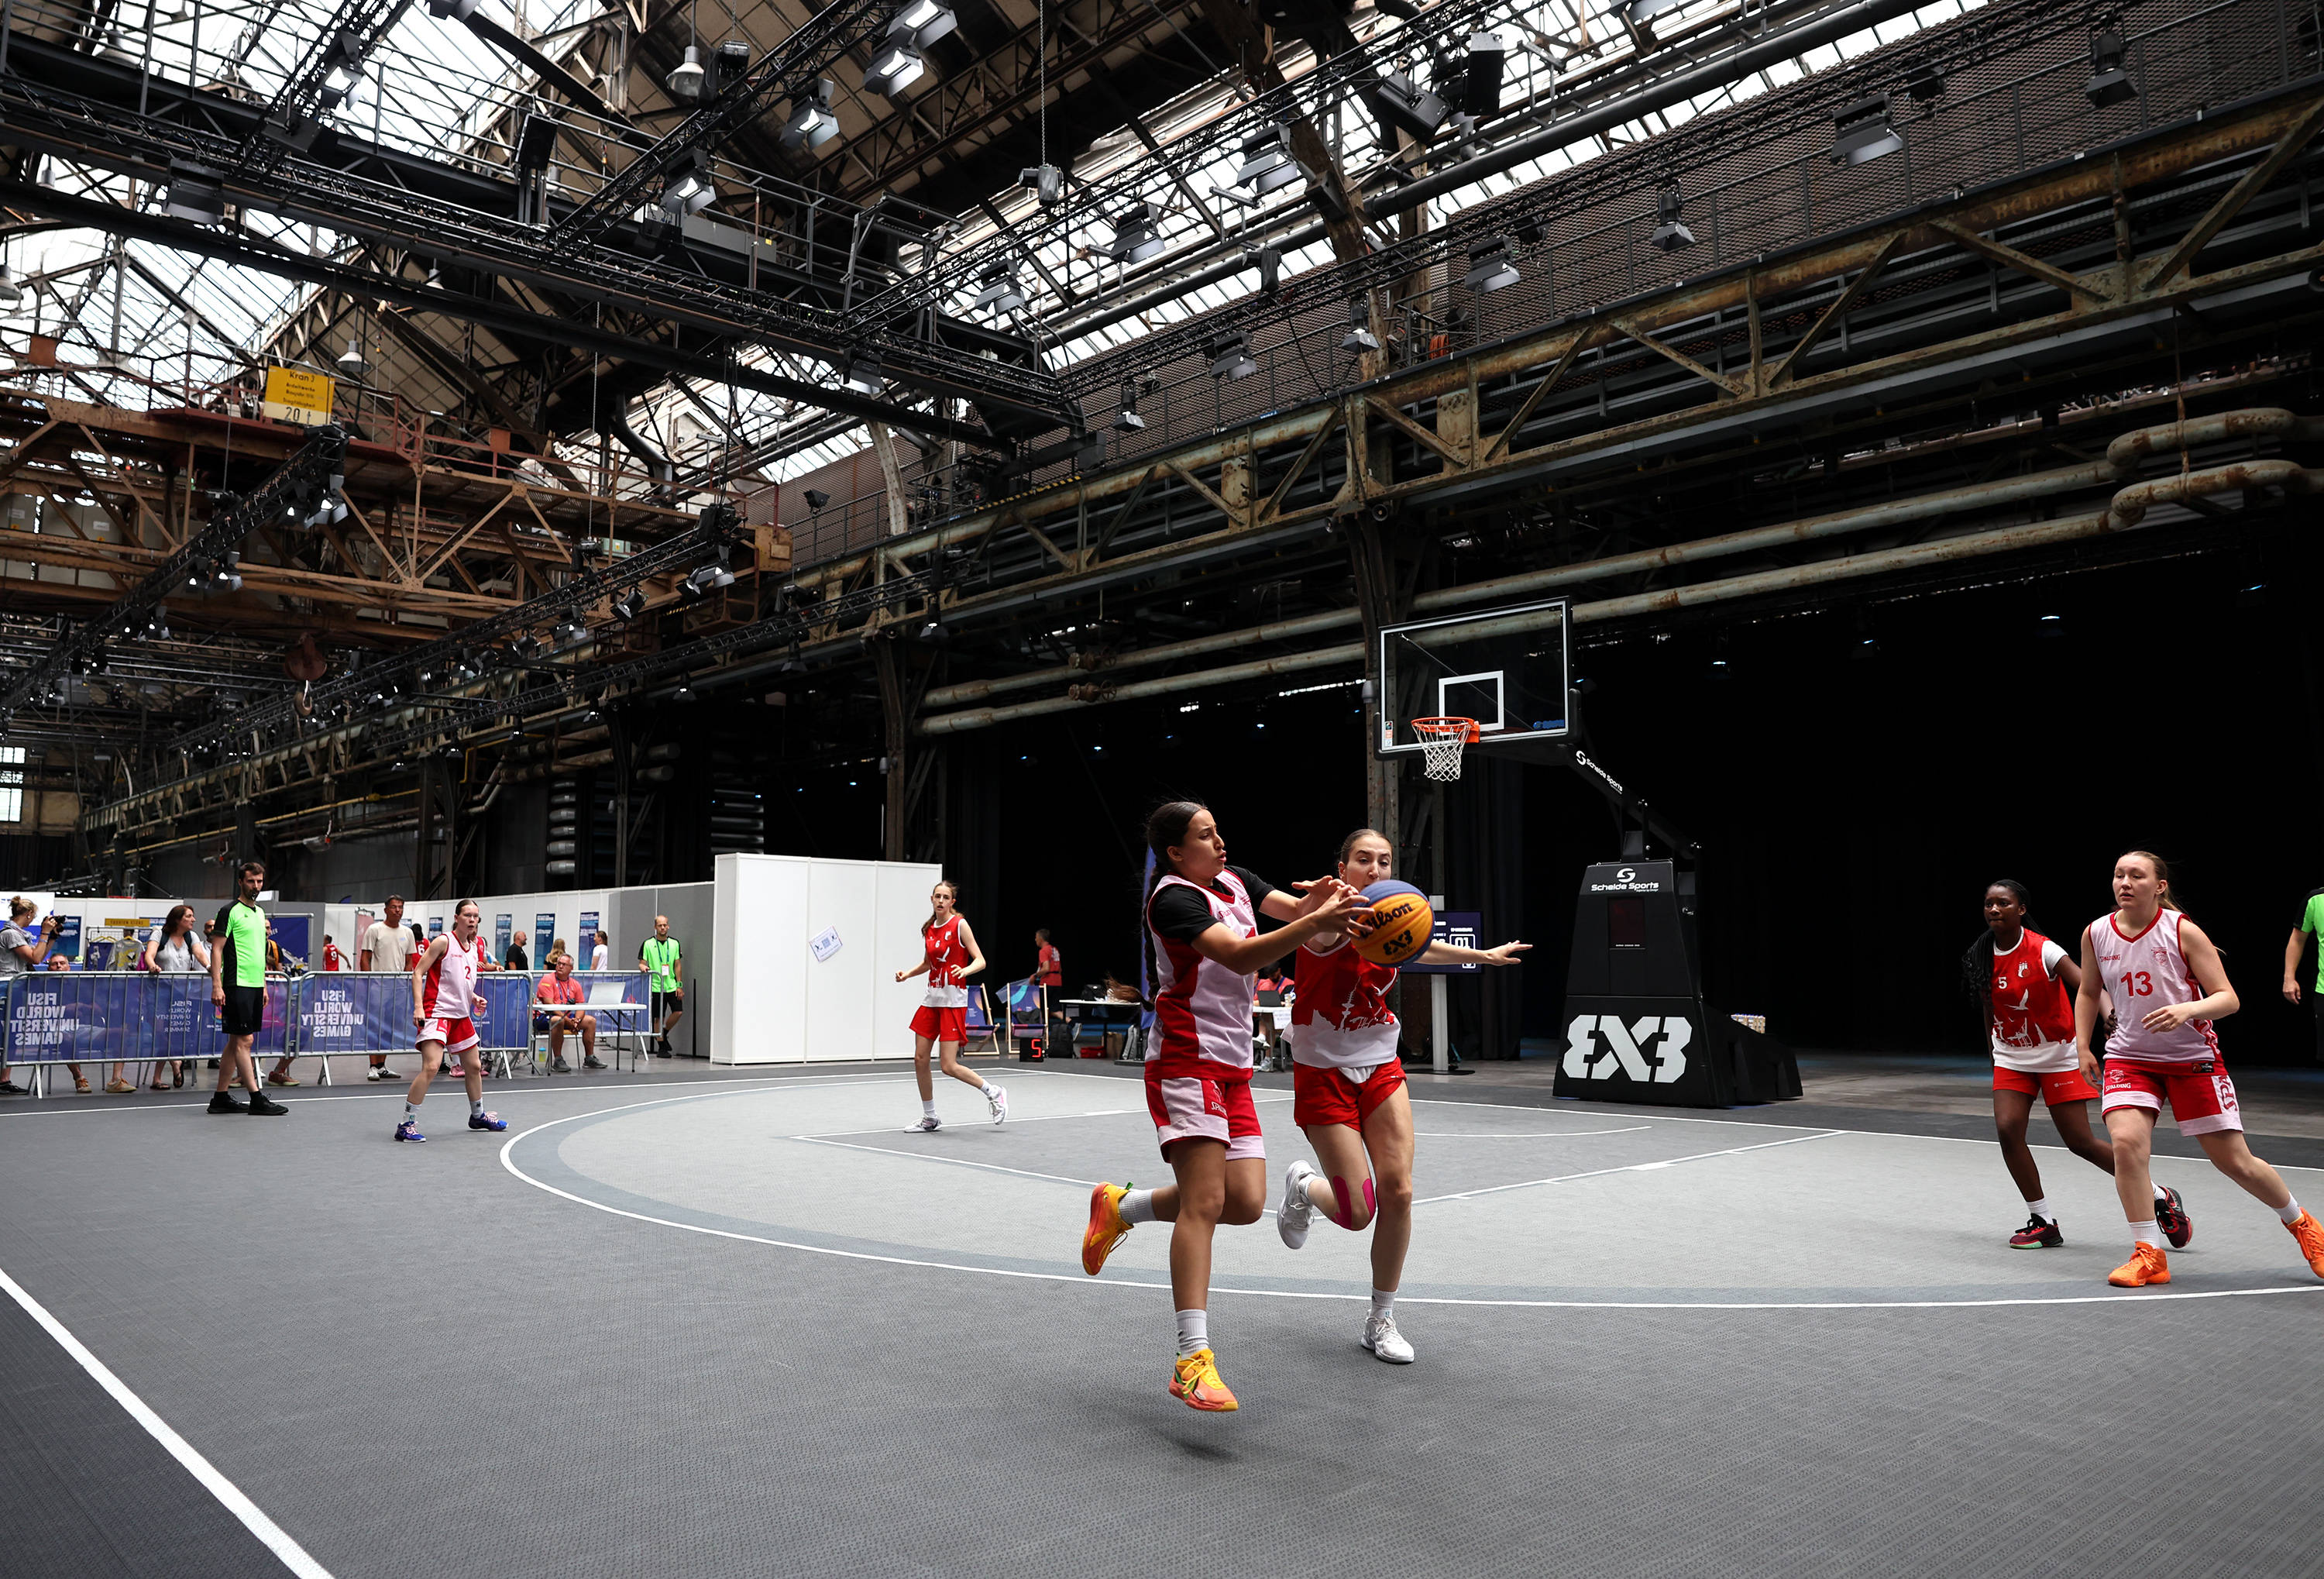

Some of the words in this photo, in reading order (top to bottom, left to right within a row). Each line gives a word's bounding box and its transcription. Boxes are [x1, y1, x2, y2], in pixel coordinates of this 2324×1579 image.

[289, 371, 309, 381] Kran
[284, 407, 301, 421] 20
[1587, 759, 1607, 779] Schelde
[1607, 775, 1623, 791] Sports
[1628, 882, 1659, 891] Sports
[418, 944, 425, 955] 6
[935, 940, 940, 948] 6
[331, 951, 338, 961] 9
[464, 966, 471, 980] 2
[1998, 976, 2008, 989] 5
[2120, 971, 2154, 997] 13
[1031, 1039, 1041, 1058] 5
[2105, 1082, 2132, 1092] SPALDING
